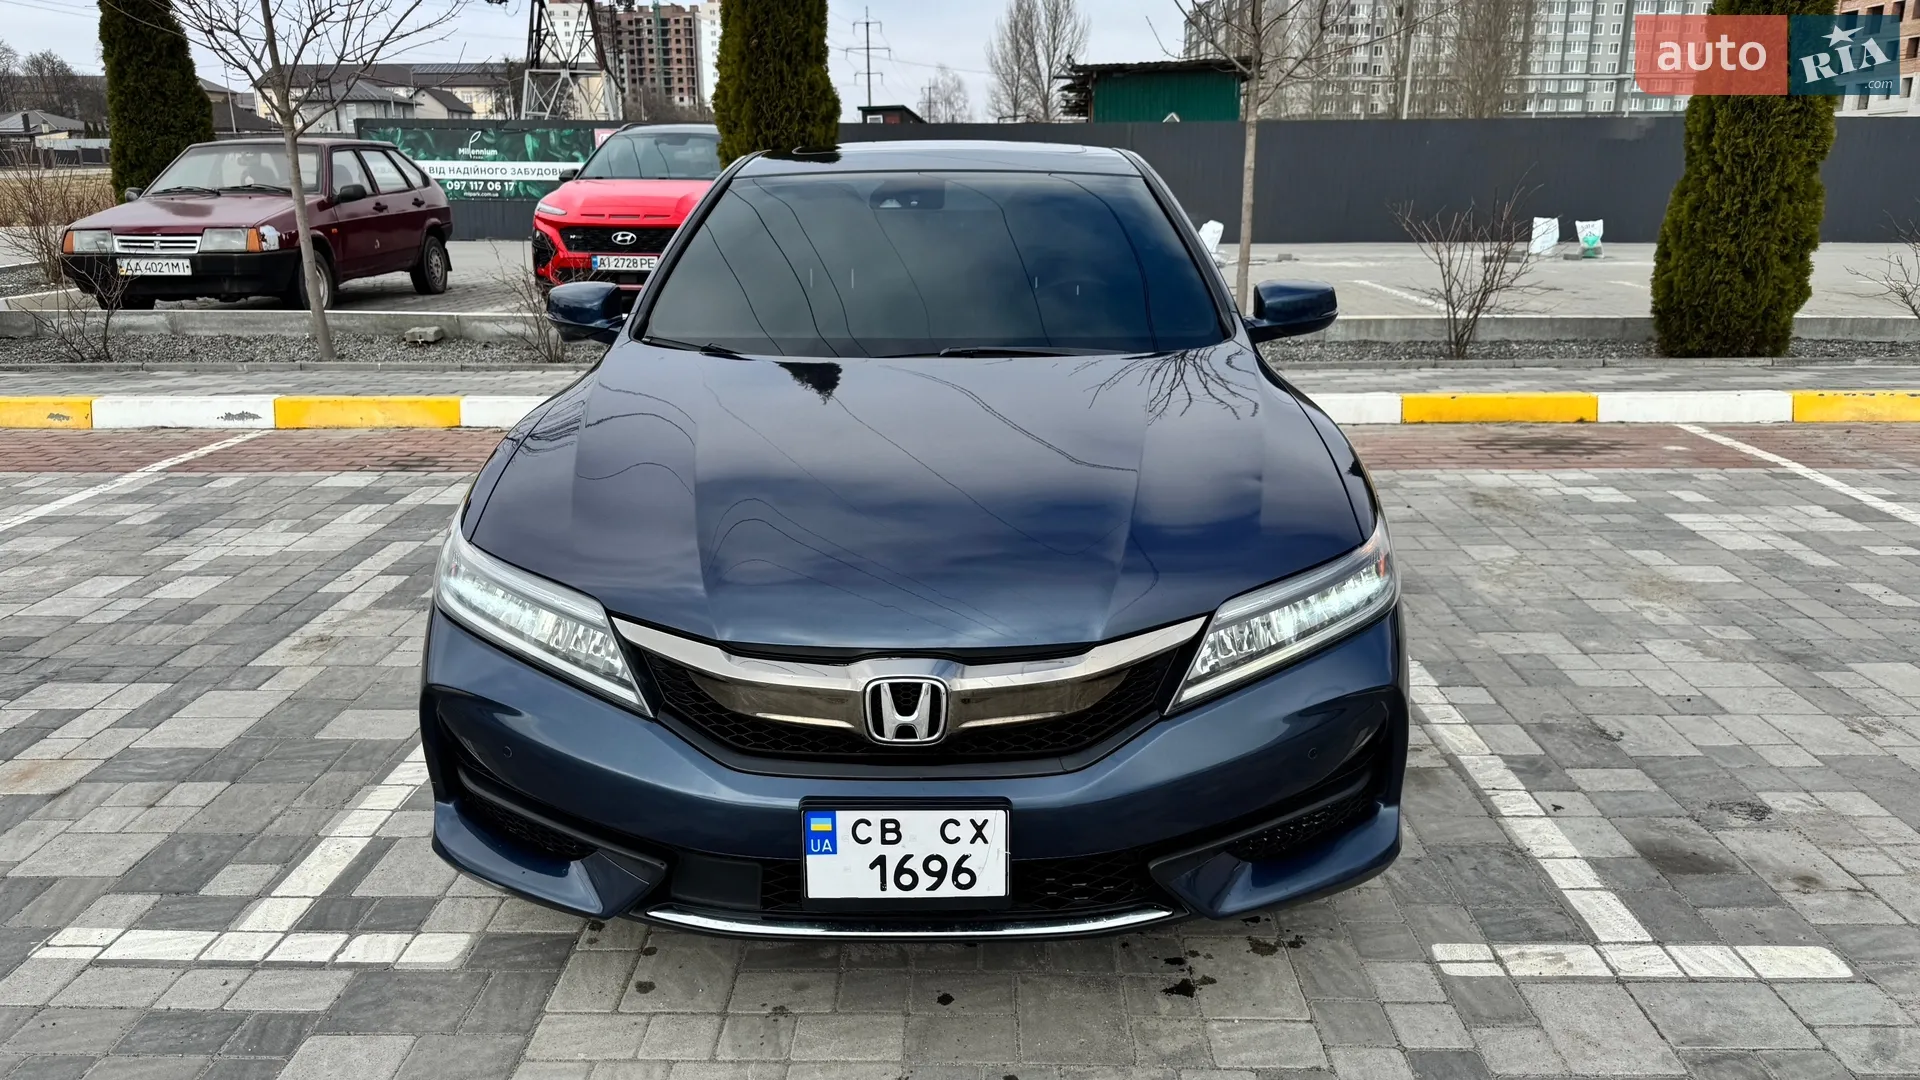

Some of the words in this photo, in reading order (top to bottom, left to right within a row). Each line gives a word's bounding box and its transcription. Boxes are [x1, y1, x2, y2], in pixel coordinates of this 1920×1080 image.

[428, 166, 446, 176] ВІД
[448, 164, 507, 176] НАДІЙНОГО
[446, 180, 465, 191] 097
[469, 181, 484, 191] 117
[487, 181, 501, 191] 06
[504, 181, 515, 191] 17
[614, 257, 638, 269] 2728
[640, 258, 655, 269] PE
[810, 839, 833, 852] UA
[868, 853, 977, 892] 1696
